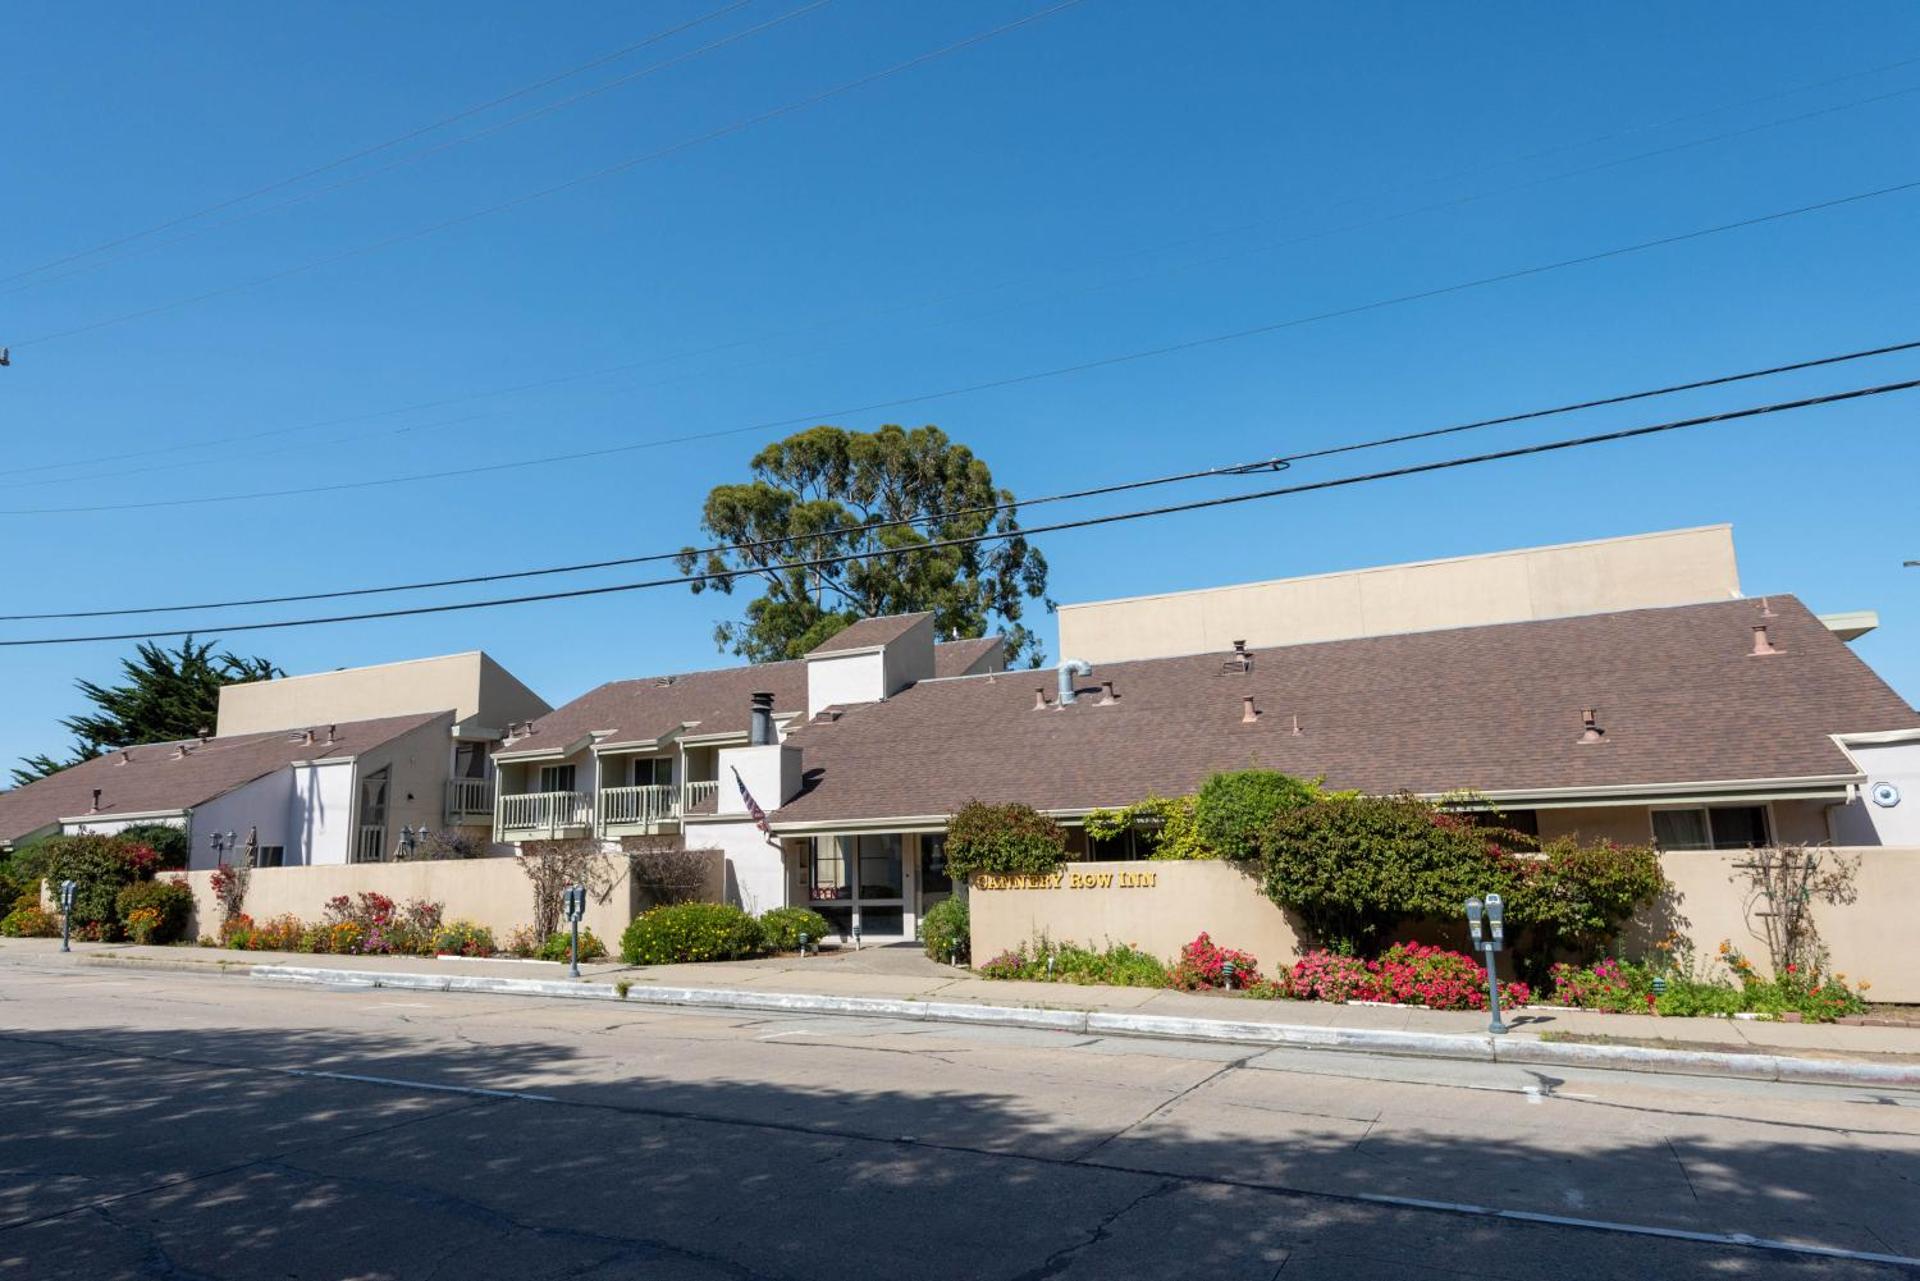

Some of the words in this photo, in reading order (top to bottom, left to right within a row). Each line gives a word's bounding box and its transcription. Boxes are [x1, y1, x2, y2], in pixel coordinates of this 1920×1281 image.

[975, 873, 1062, 890] CANNERY
[1069, 872, 1113, 889] ROW
[1119, 871, 1156, 888] INN
[810, 887, 839, 900] OPEN
